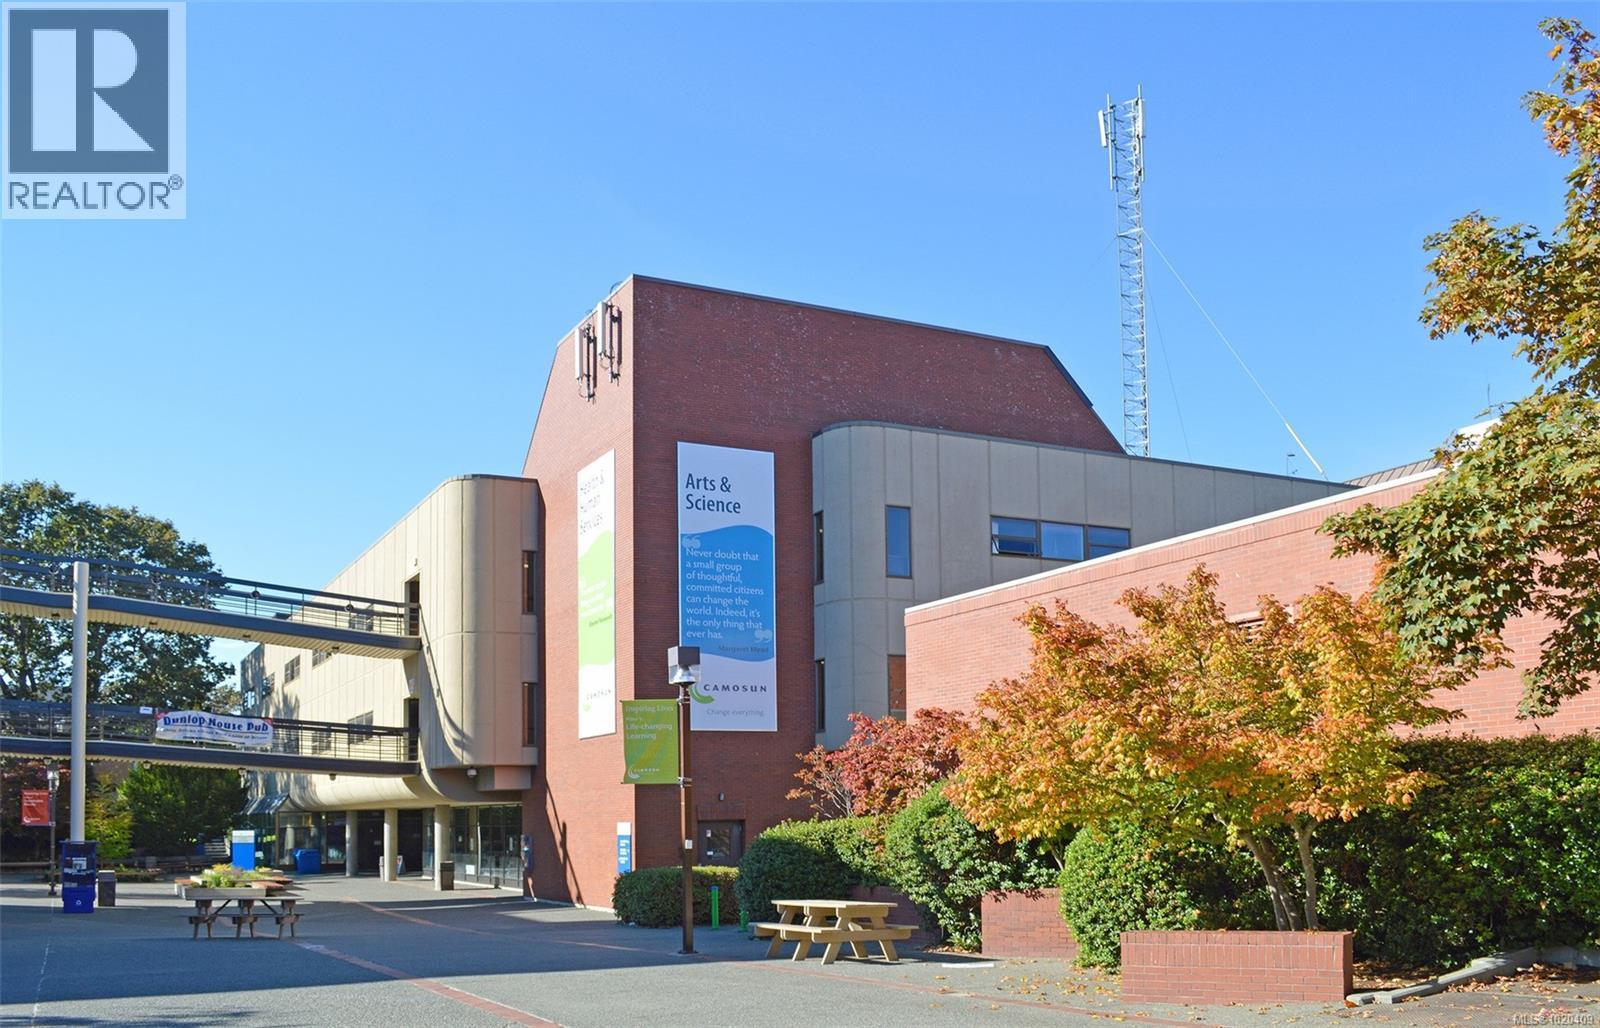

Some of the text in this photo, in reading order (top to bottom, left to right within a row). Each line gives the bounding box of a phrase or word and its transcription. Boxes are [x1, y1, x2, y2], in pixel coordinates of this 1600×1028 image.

[685, 472, 732, 493] Arts &
[685, 493, 741, 514] Science
[686, 548, 759, 561] Never doubt that
[693, 560, 714, 569] small
[716, 562, 742, 573] group
[686, 570, 743, 584] of thoughtful,
[686, 584, 764, 595] committed citizens
[703, 595, 733, 607] change
[735, 596, 750, 606] the
[686, 605, 761, 618] world. Indeed, it's
[686, 617, 763, 631] the only thing that
[707, 629, 724, 639] has.
[703, 683, 767, 693] CAMOSUN
[163, 713, 269, 732] Dunlop House Pub
